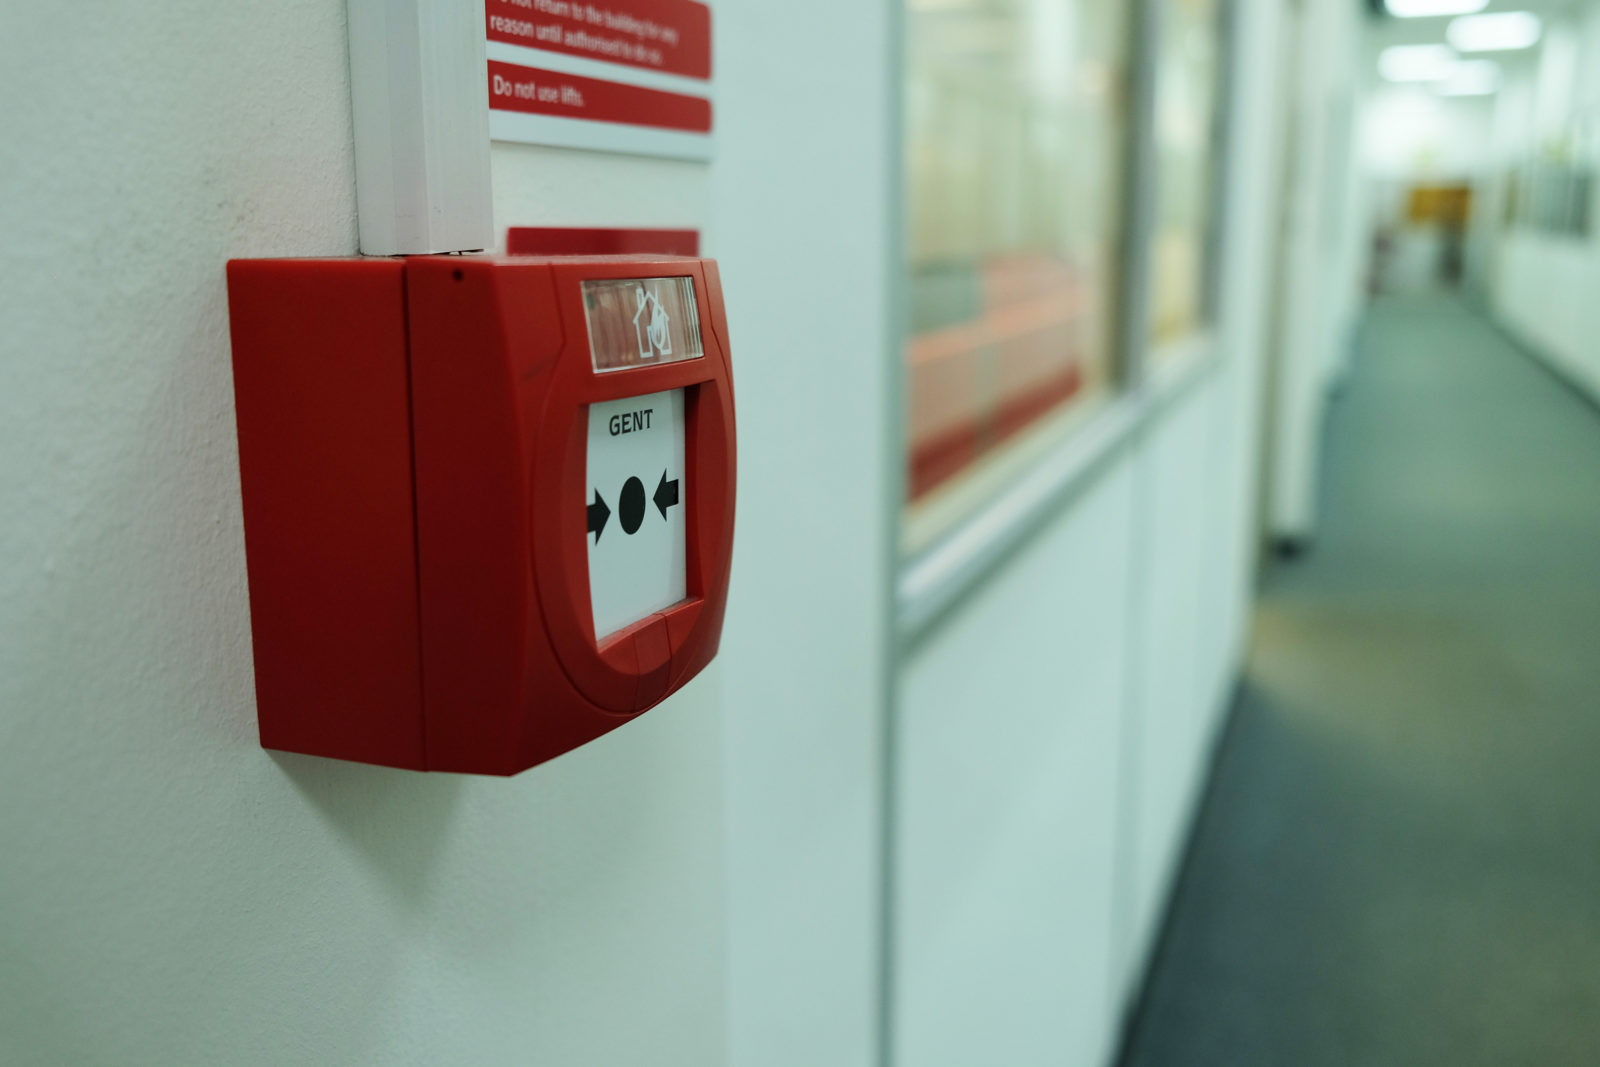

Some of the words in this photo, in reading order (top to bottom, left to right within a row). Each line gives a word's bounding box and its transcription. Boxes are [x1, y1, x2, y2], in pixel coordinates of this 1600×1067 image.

[490, 15, 534, 37] reason
[536, 25, 562, 43] until
[493, 75, 512, 96] Do
[515, 82, 535, 99] not
[538, 86, 558, 102] use
[609, 409, 653, 436] GENT
